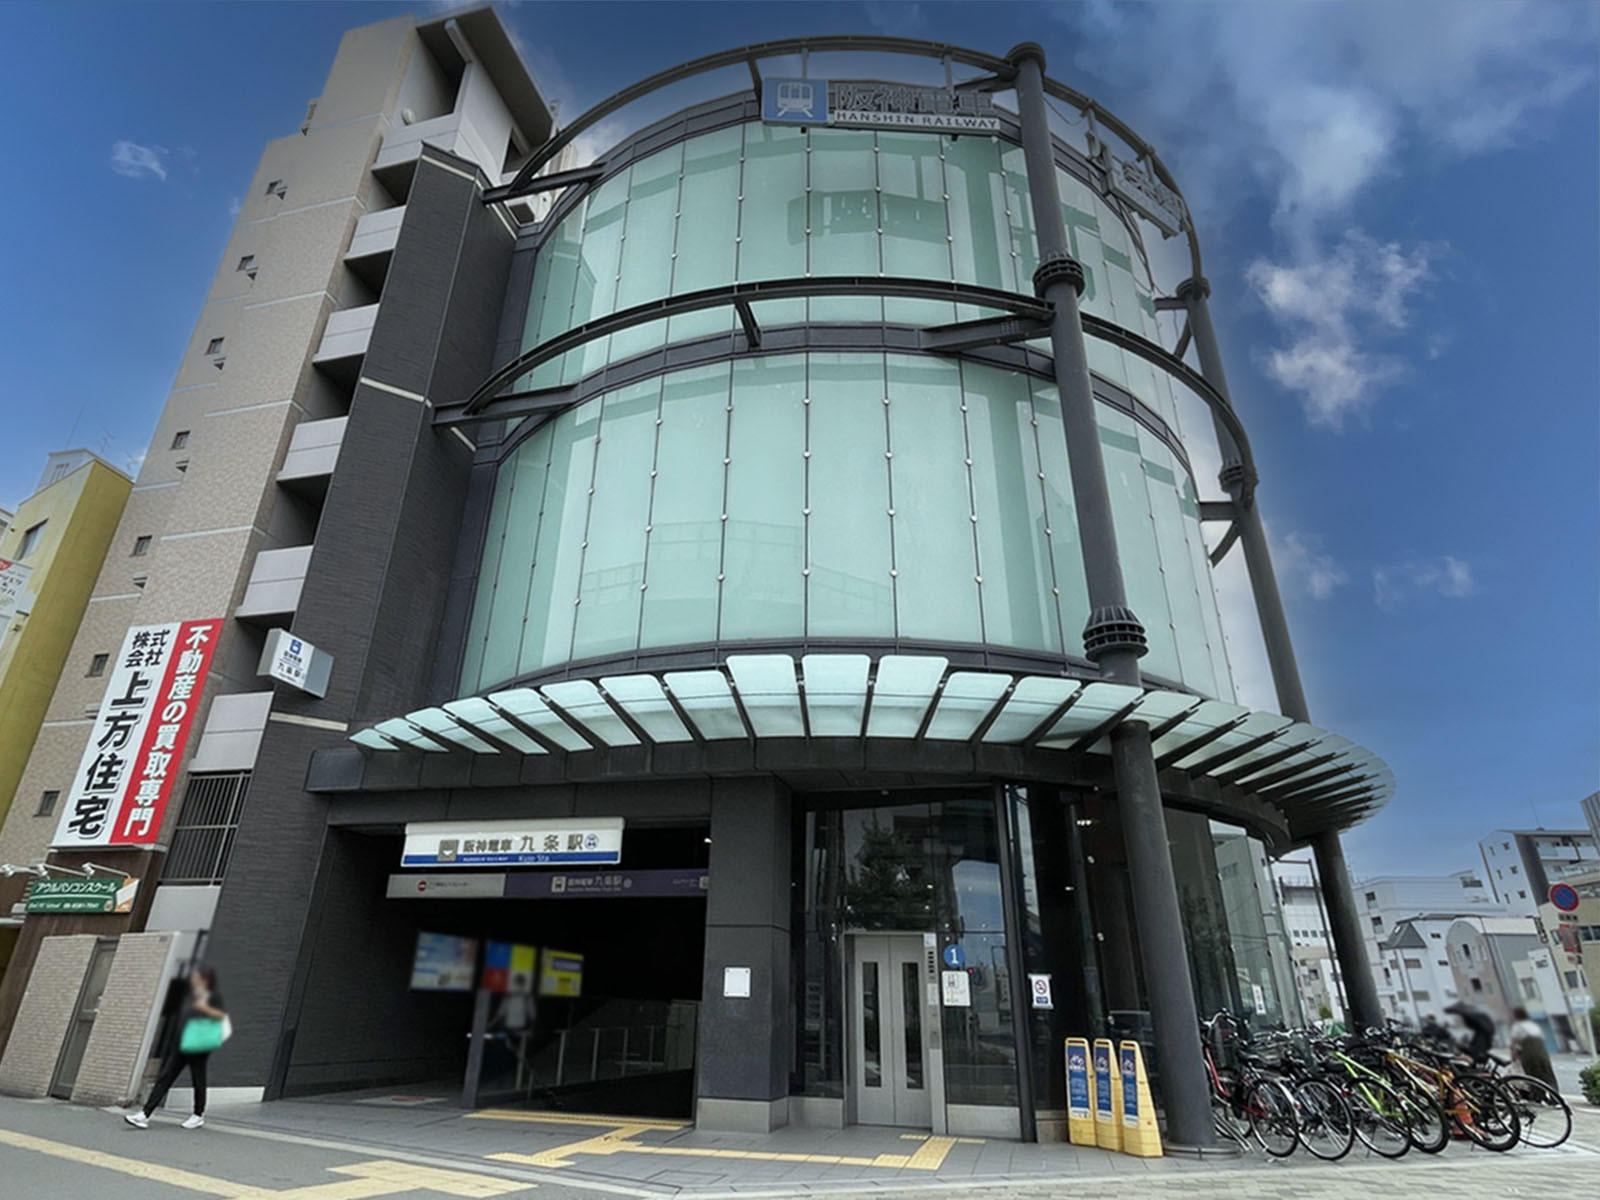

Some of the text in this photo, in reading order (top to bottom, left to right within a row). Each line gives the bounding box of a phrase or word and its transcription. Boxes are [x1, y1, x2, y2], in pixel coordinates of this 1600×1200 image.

[836, 111, 997, 128] HANSHIN RAILWAY
[132, 629, 170, 649] 株式
[125, 648, 164, 668] 会社
[123, 624, 212, 837] 不動産の買取専門
[67, 671, 151, 839] 上方住宅
[463, 834, 583, 853] 阪神電車 九条駅
[950, 948, 959, 964] 1
